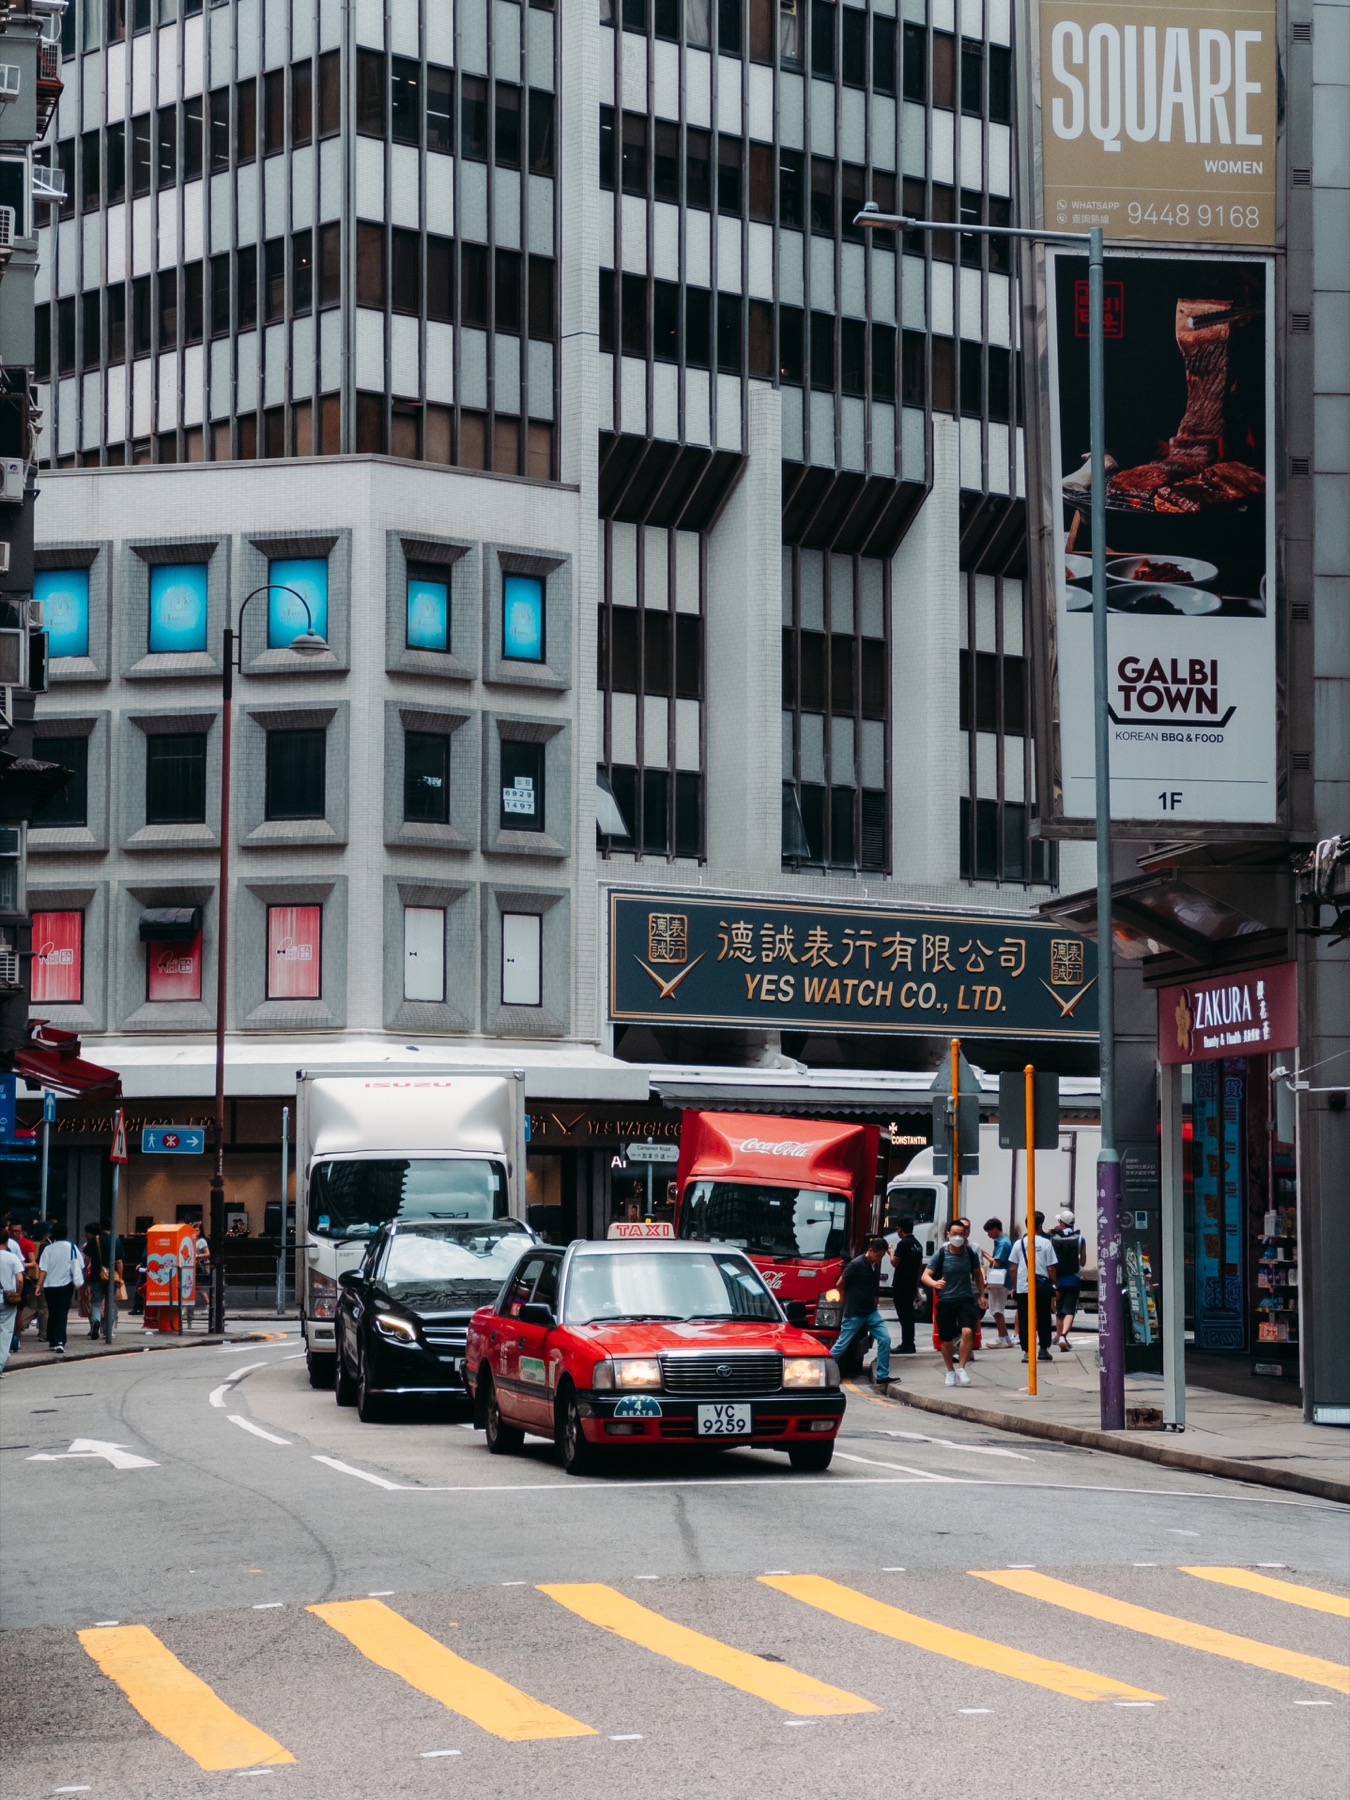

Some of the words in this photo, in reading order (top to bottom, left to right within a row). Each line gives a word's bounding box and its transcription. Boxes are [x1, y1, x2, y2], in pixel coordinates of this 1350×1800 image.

[1051, 20, 1263, 152] SQUARE
[1204, 159, 1264, 175] WOMEN
[1071, 201, 1120, 211] WHATSAPP
[1127, 201, 1190, 227] 9448
[1197, 204, 1260, 228] 9168
[1117, 655, 1218, 686] GALBI
[1117, 685, 1219, 714] TOWN
[1115, 731, 1159, 742] KOREAN
[1161, 732, 1185, 743] BBQ
[1185, 733, 1193, 743] &
[1194, 733, 1225, 743] FOOD
[504, 790, 532, 799] 6929
[1158, 791, 1183, 811] 1F
[506, 802, 532, 810] 1497
[716, 920, 1026, 978] 德誠表行有限公司
[744, 972, 795, 1003] YES
[803, 976, 894, 1007] WATCH
[900, 981, 948, 1015] CO.,
[957, 984, 1007, 1013] LTD.
[1194, 984, 1252, 1029] ZAKURA
[739, 1137, 810, 1158] Coca-Cola
[892, 1135, 926, 1145] CONSTANTIN
[616, 1224, 670, 1237] TAXI
[633, 1400, 642, 1411] 4
[714, 1405, 735, 1419] VC
[703, 1418, 746, 1433] 9259
